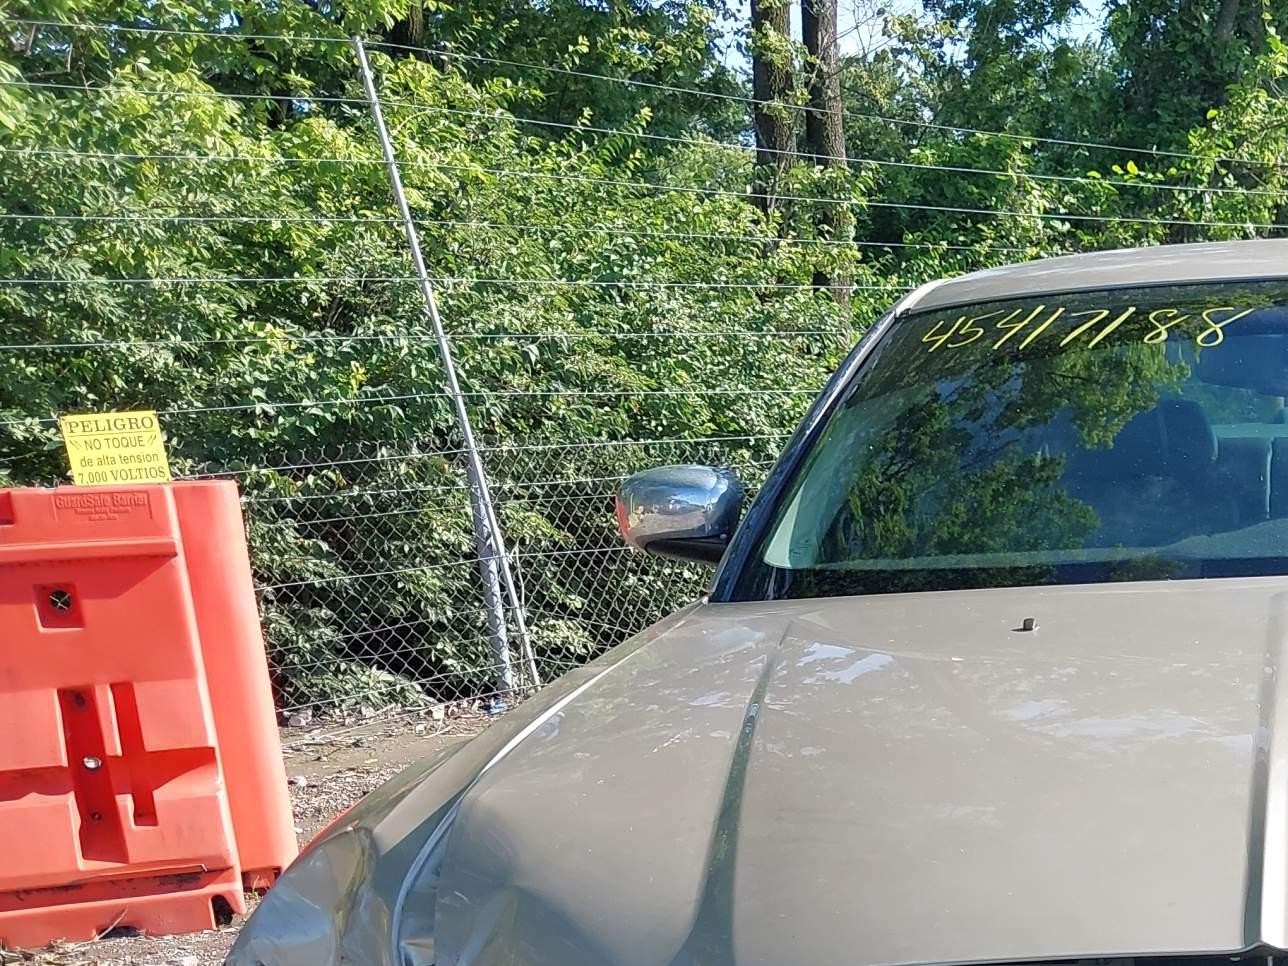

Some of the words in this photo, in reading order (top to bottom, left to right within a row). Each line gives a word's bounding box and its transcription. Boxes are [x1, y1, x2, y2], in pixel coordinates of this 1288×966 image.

[922, 304, 1255, 352] 45417188
[66, 416, 154, 434] PELIGRO
[84, 438, 102, 450] NO
[103, 435, 146, 449] TOQUE
[79, 456, 94, 468] de
[97, 454, 116, 467] alta
[119, 453, 159, 465] tension
[110, 466, 166, 481] VOLTIOS
